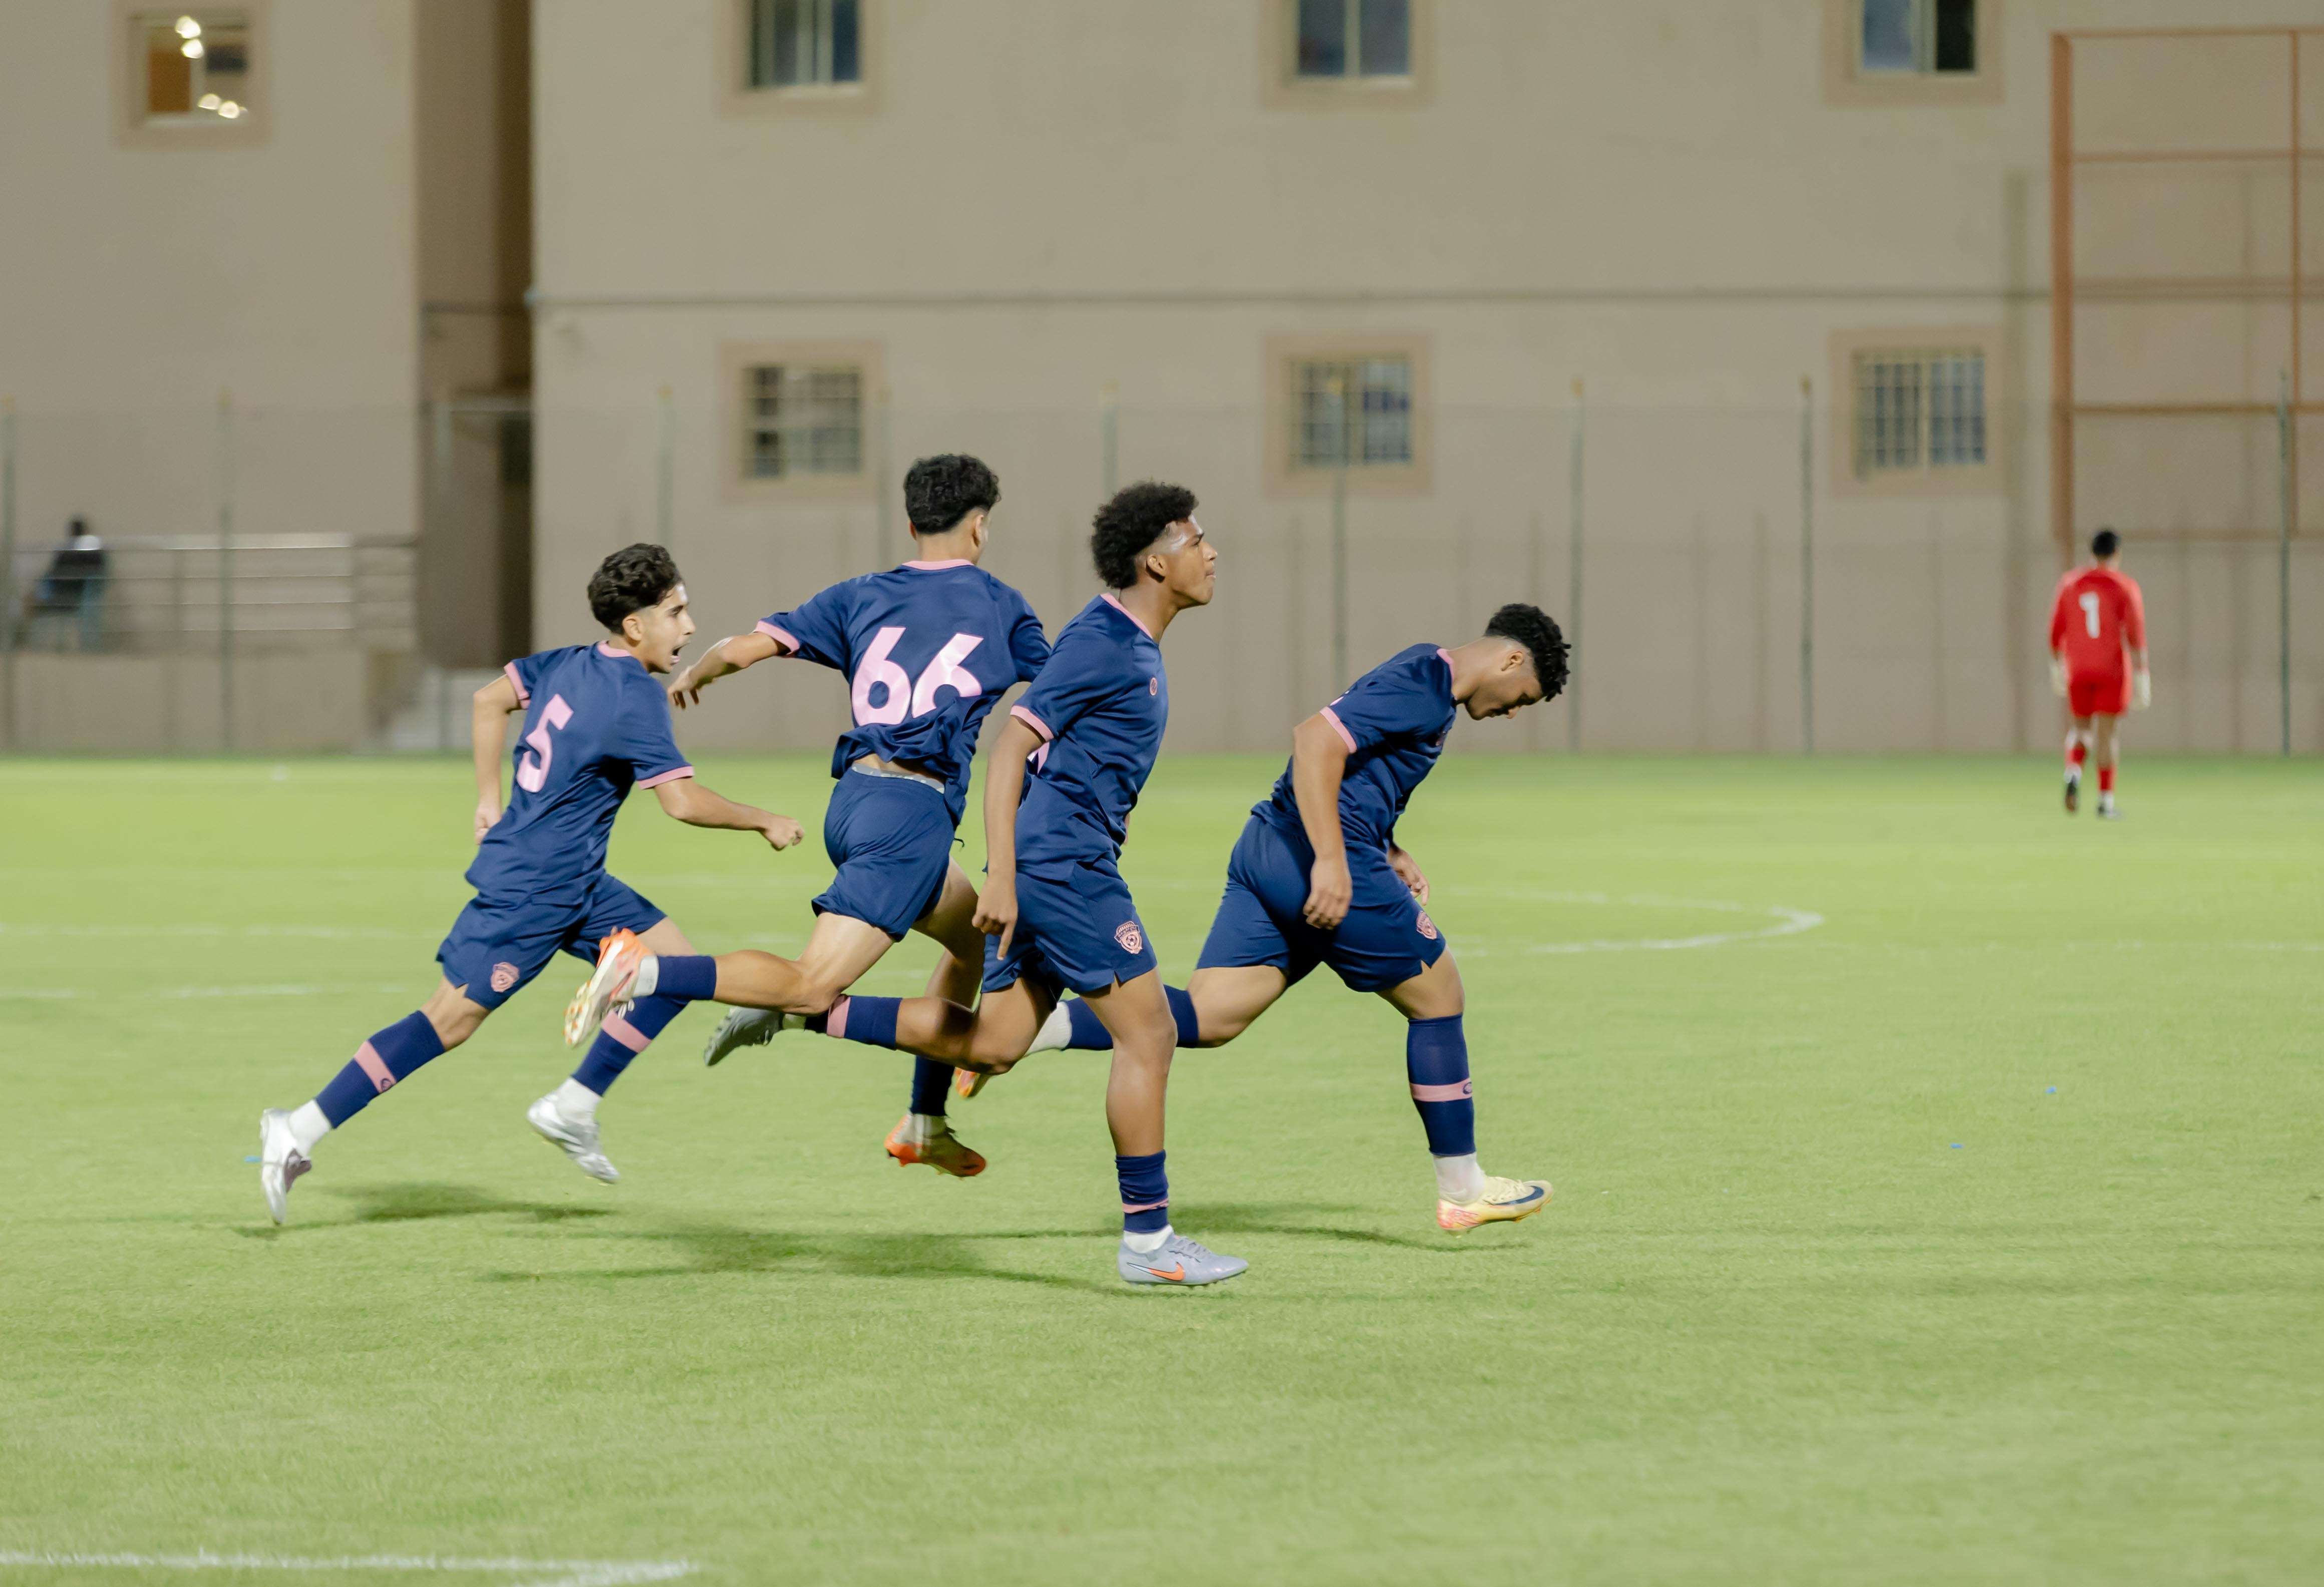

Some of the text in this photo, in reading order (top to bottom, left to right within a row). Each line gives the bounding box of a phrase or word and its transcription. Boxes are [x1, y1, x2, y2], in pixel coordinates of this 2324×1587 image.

[2079, 591, 2100, 639] 1
[851, 626, 984, 726] 66
[516, 694, 573, 792] 5
